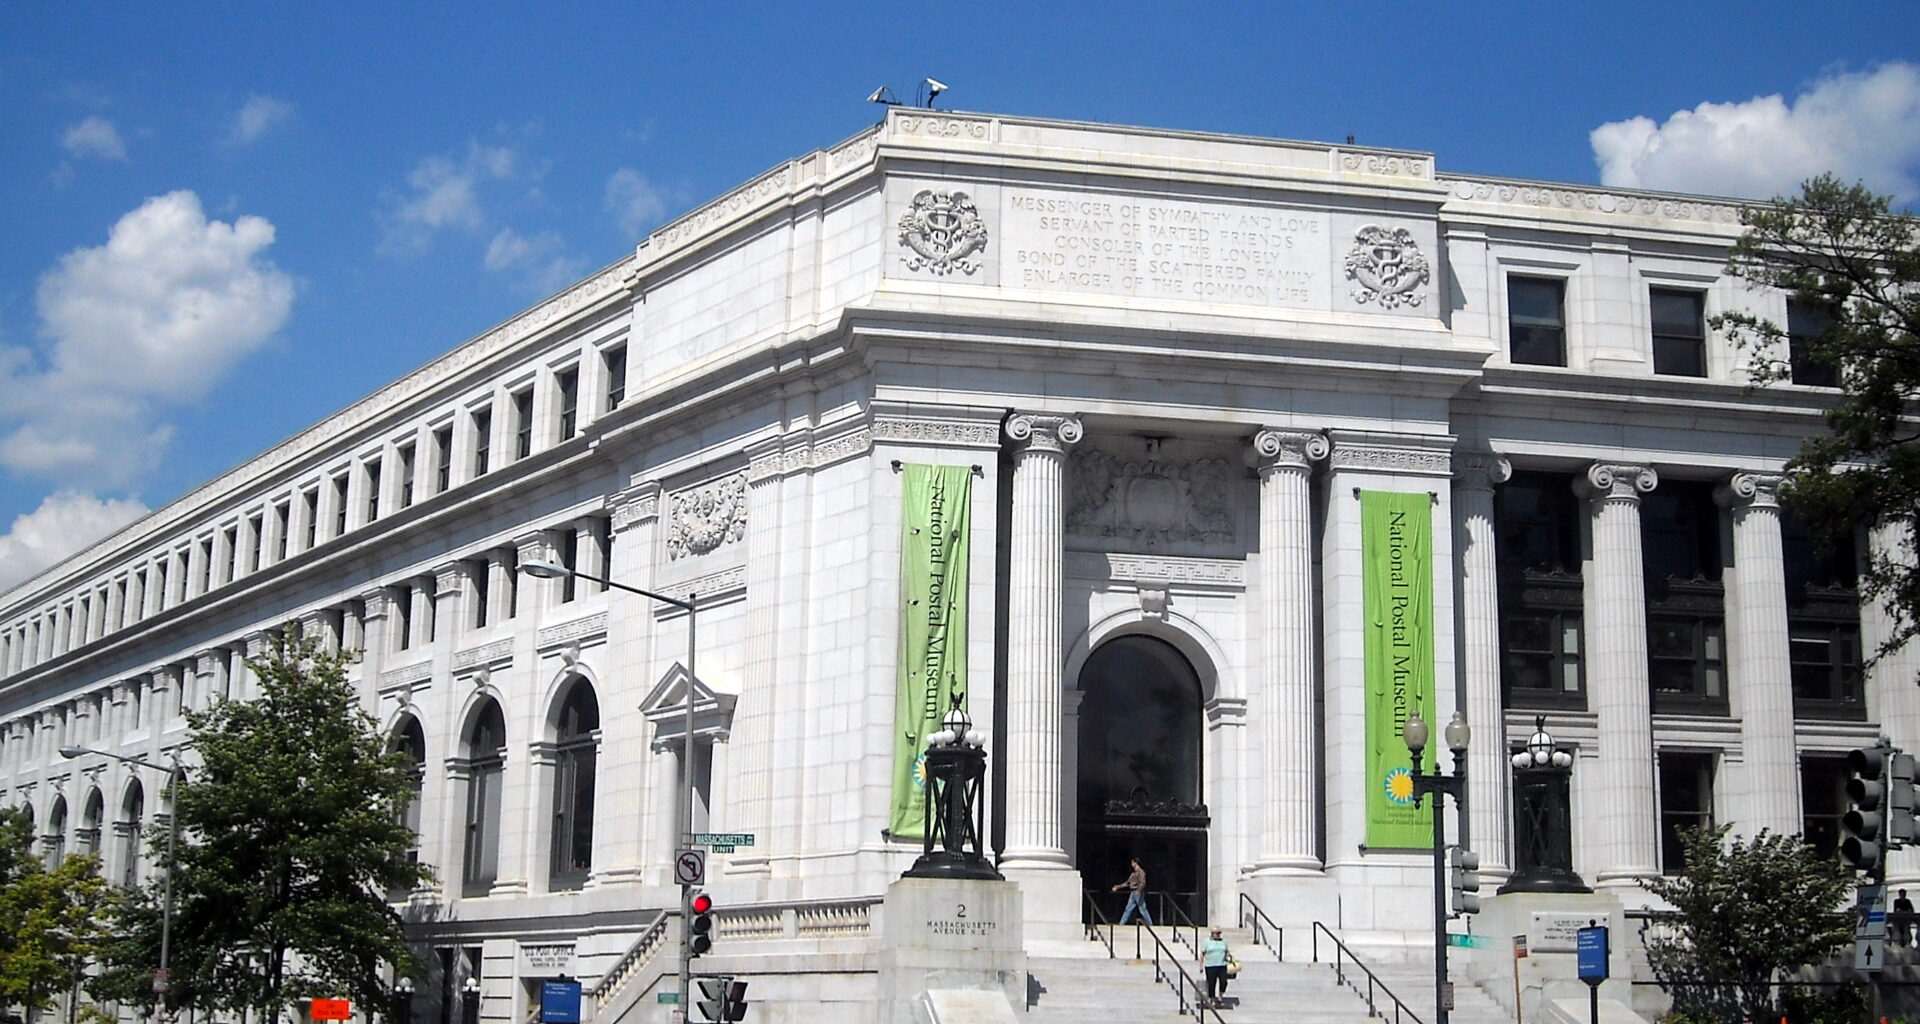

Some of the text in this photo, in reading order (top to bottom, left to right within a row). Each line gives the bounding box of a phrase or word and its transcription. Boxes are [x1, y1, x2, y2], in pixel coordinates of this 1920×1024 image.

[1011, 196, 1319, 233] MESSENGER OF SYMPATHY AND LOVE
[1039, 217, 1294, 248] SERVANT OF PARTED FRIENDS
[1055, 235, 1280, 264] CONSOLER OF THE LONELY
[1018, 250, 1314, 284] BOND OF THE SCATTERED FAMILY
[1023, 269, 1309, 301] ENLARGER OF THE COMMON LIFE
[925, 485, 946, 721] National Postal Museum
[1389, 511, 1411, 738] National Postal Museum
[696, 835, 745, 844] MASSACHUSETTS
[713, 845, 734, 853] UNIT
[927, 921, 996, 929] MASSACHUSETTS
[957, 904, 966, 918] 2
